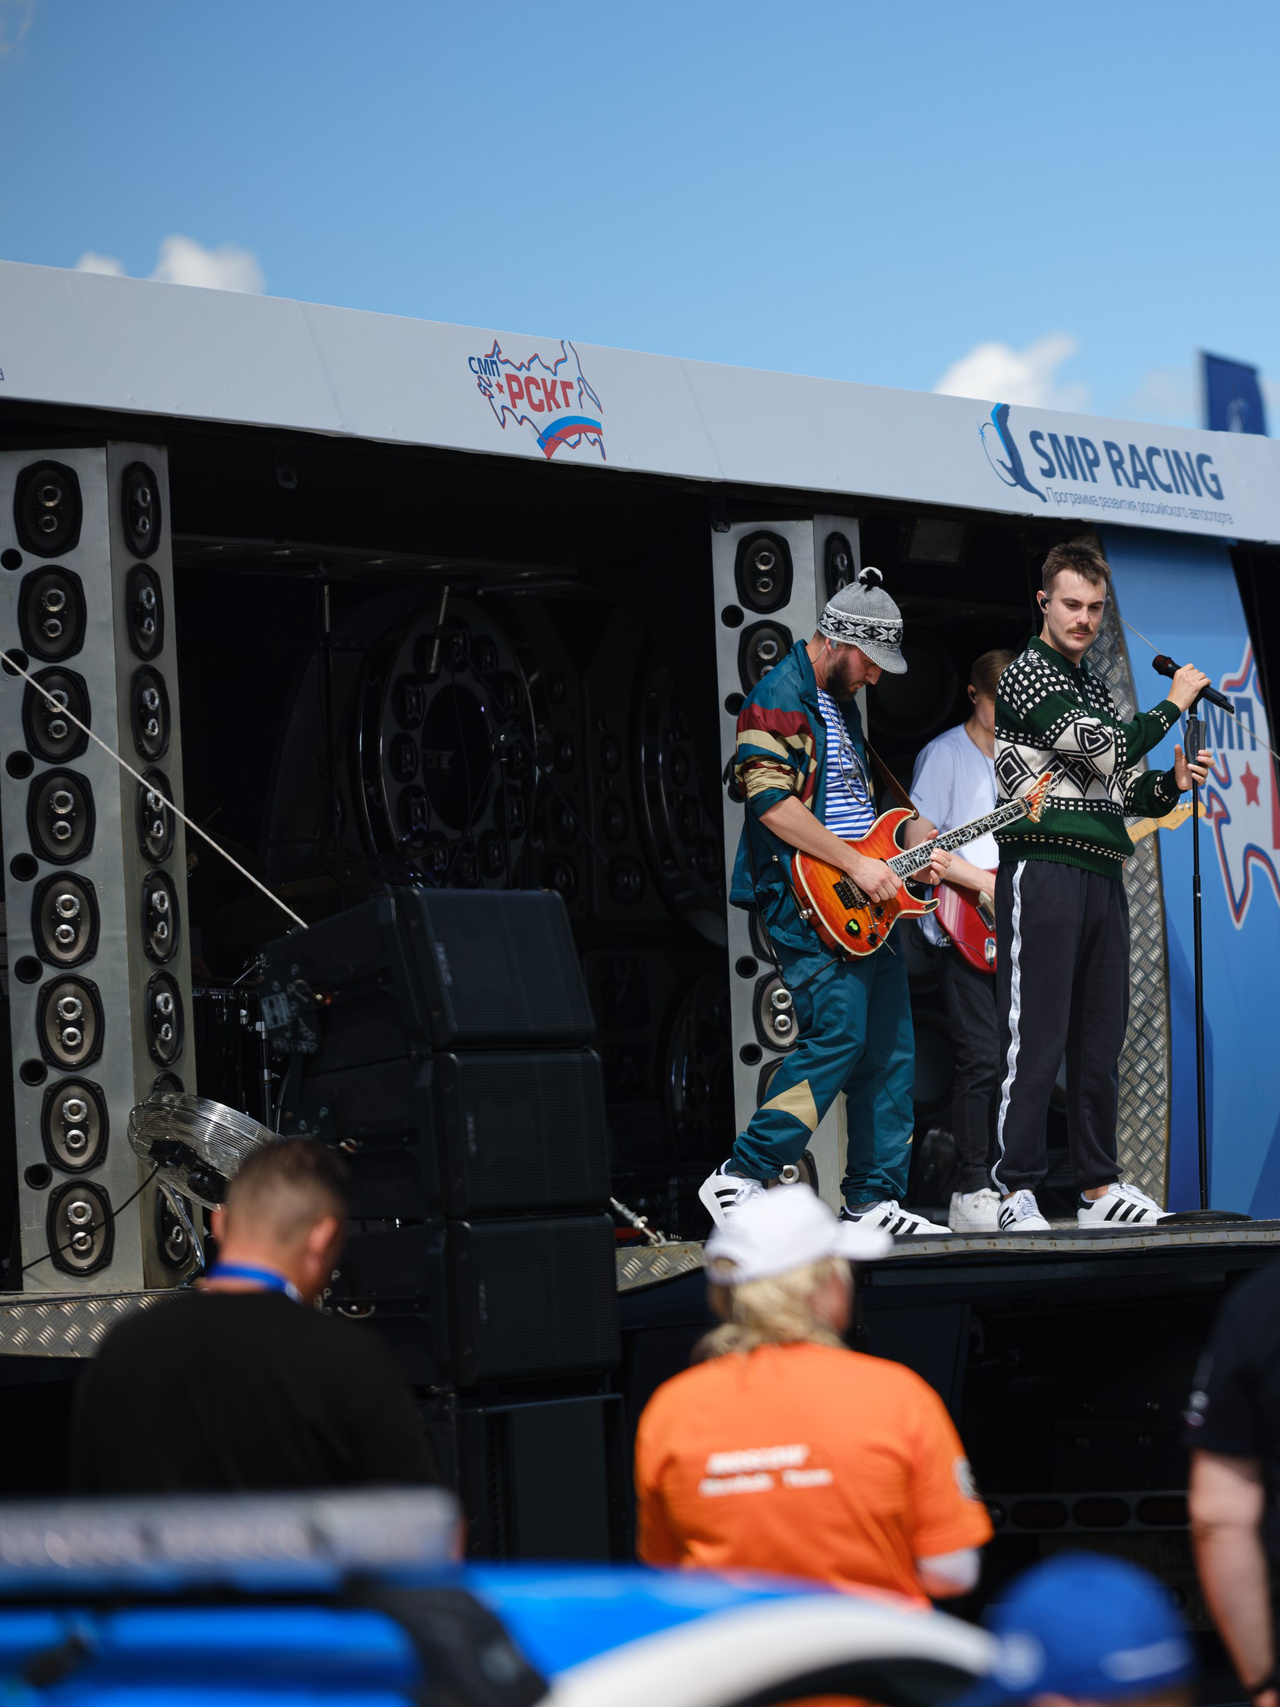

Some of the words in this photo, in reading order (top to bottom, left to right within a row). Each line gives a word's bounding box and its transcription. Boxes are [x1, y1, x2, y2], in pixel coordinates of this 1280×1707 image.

[468, 356, 501, 378] СМП
[504, 372, 574, 413] РСКГ
[1029, 430, 1101, 484] SMP
[1102, 440, 1225, 501] RACING
[1045, 486, 1099, 508] Программа
[1098, 496, 1137, 512] развития
[1137, 501, 1189, 518] российского
[1188, 508, 1235, 528] автоспорта
[1180, 695, 1257, 752] МП
